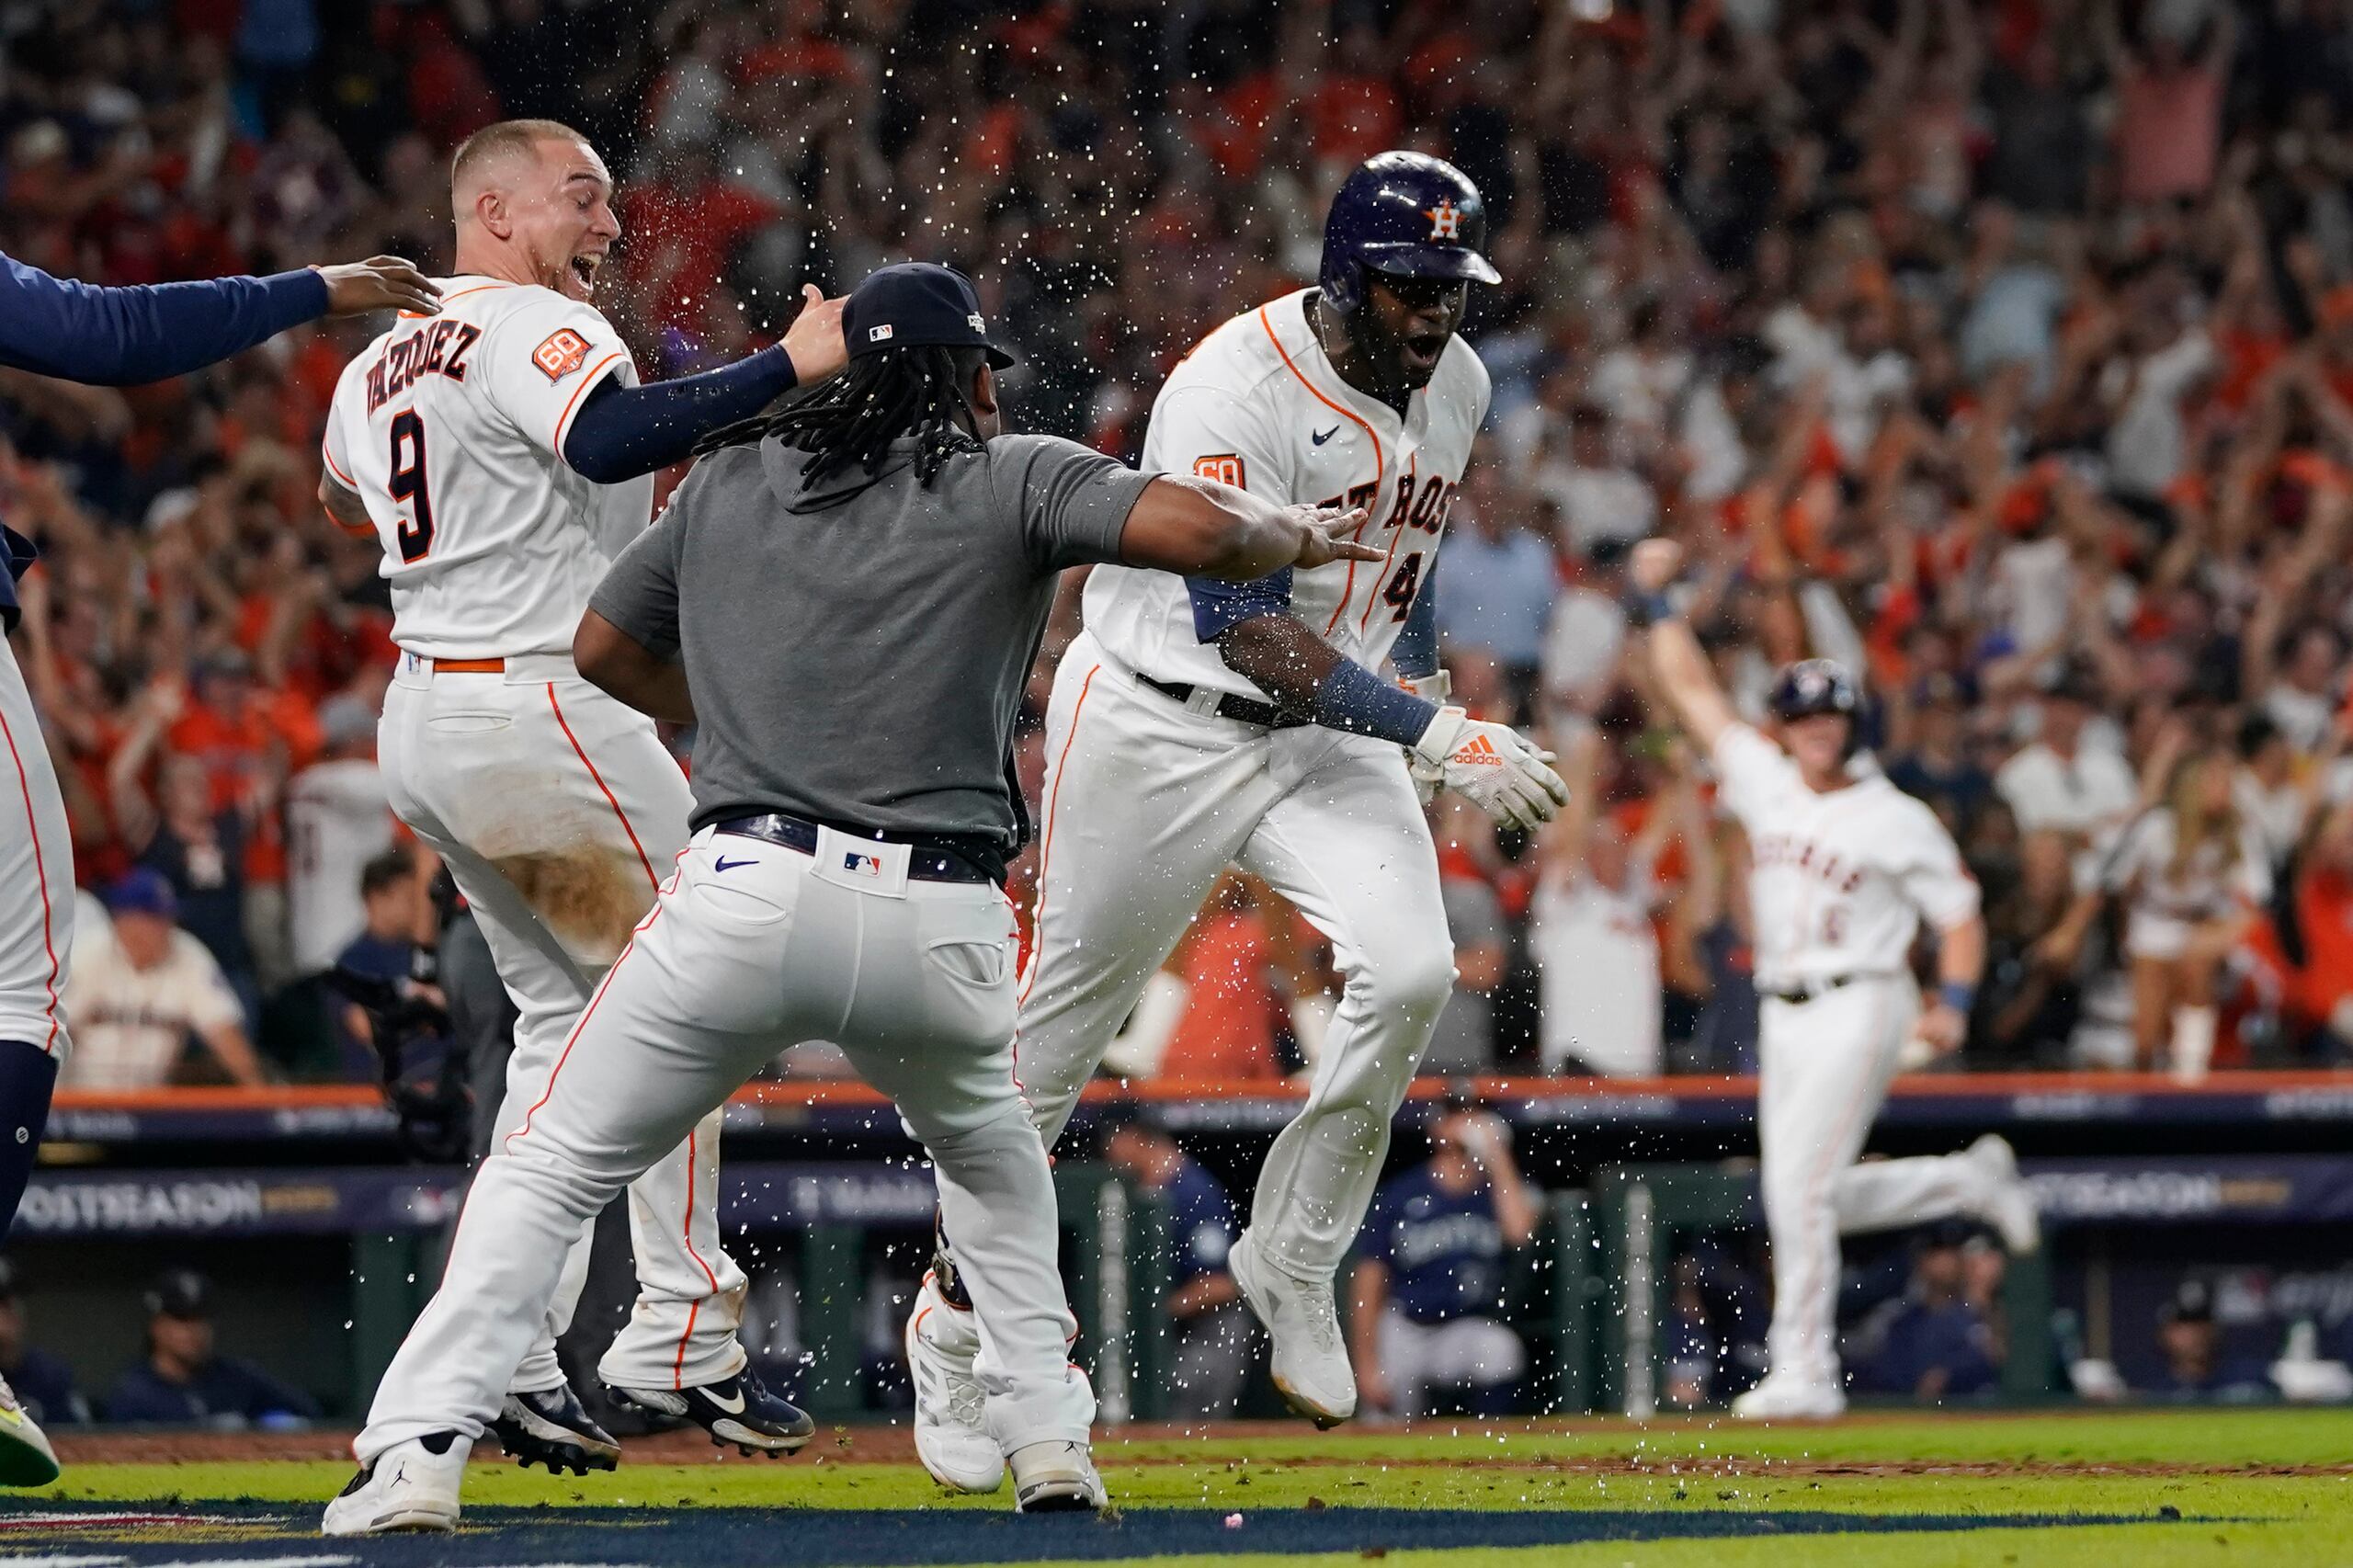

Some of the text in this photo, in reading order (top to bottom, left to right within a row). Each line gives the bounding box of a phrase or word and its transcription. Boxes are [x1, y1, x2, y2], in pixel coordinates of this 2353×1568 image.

[1431, 207, 1461, 238] H
[538, 332, 582, 370] 60
[388, 405, 435, 564] 9
[1455, 753, 1502, 767] adidas
[18, 1182, 263, 1230] OSTSEASON
